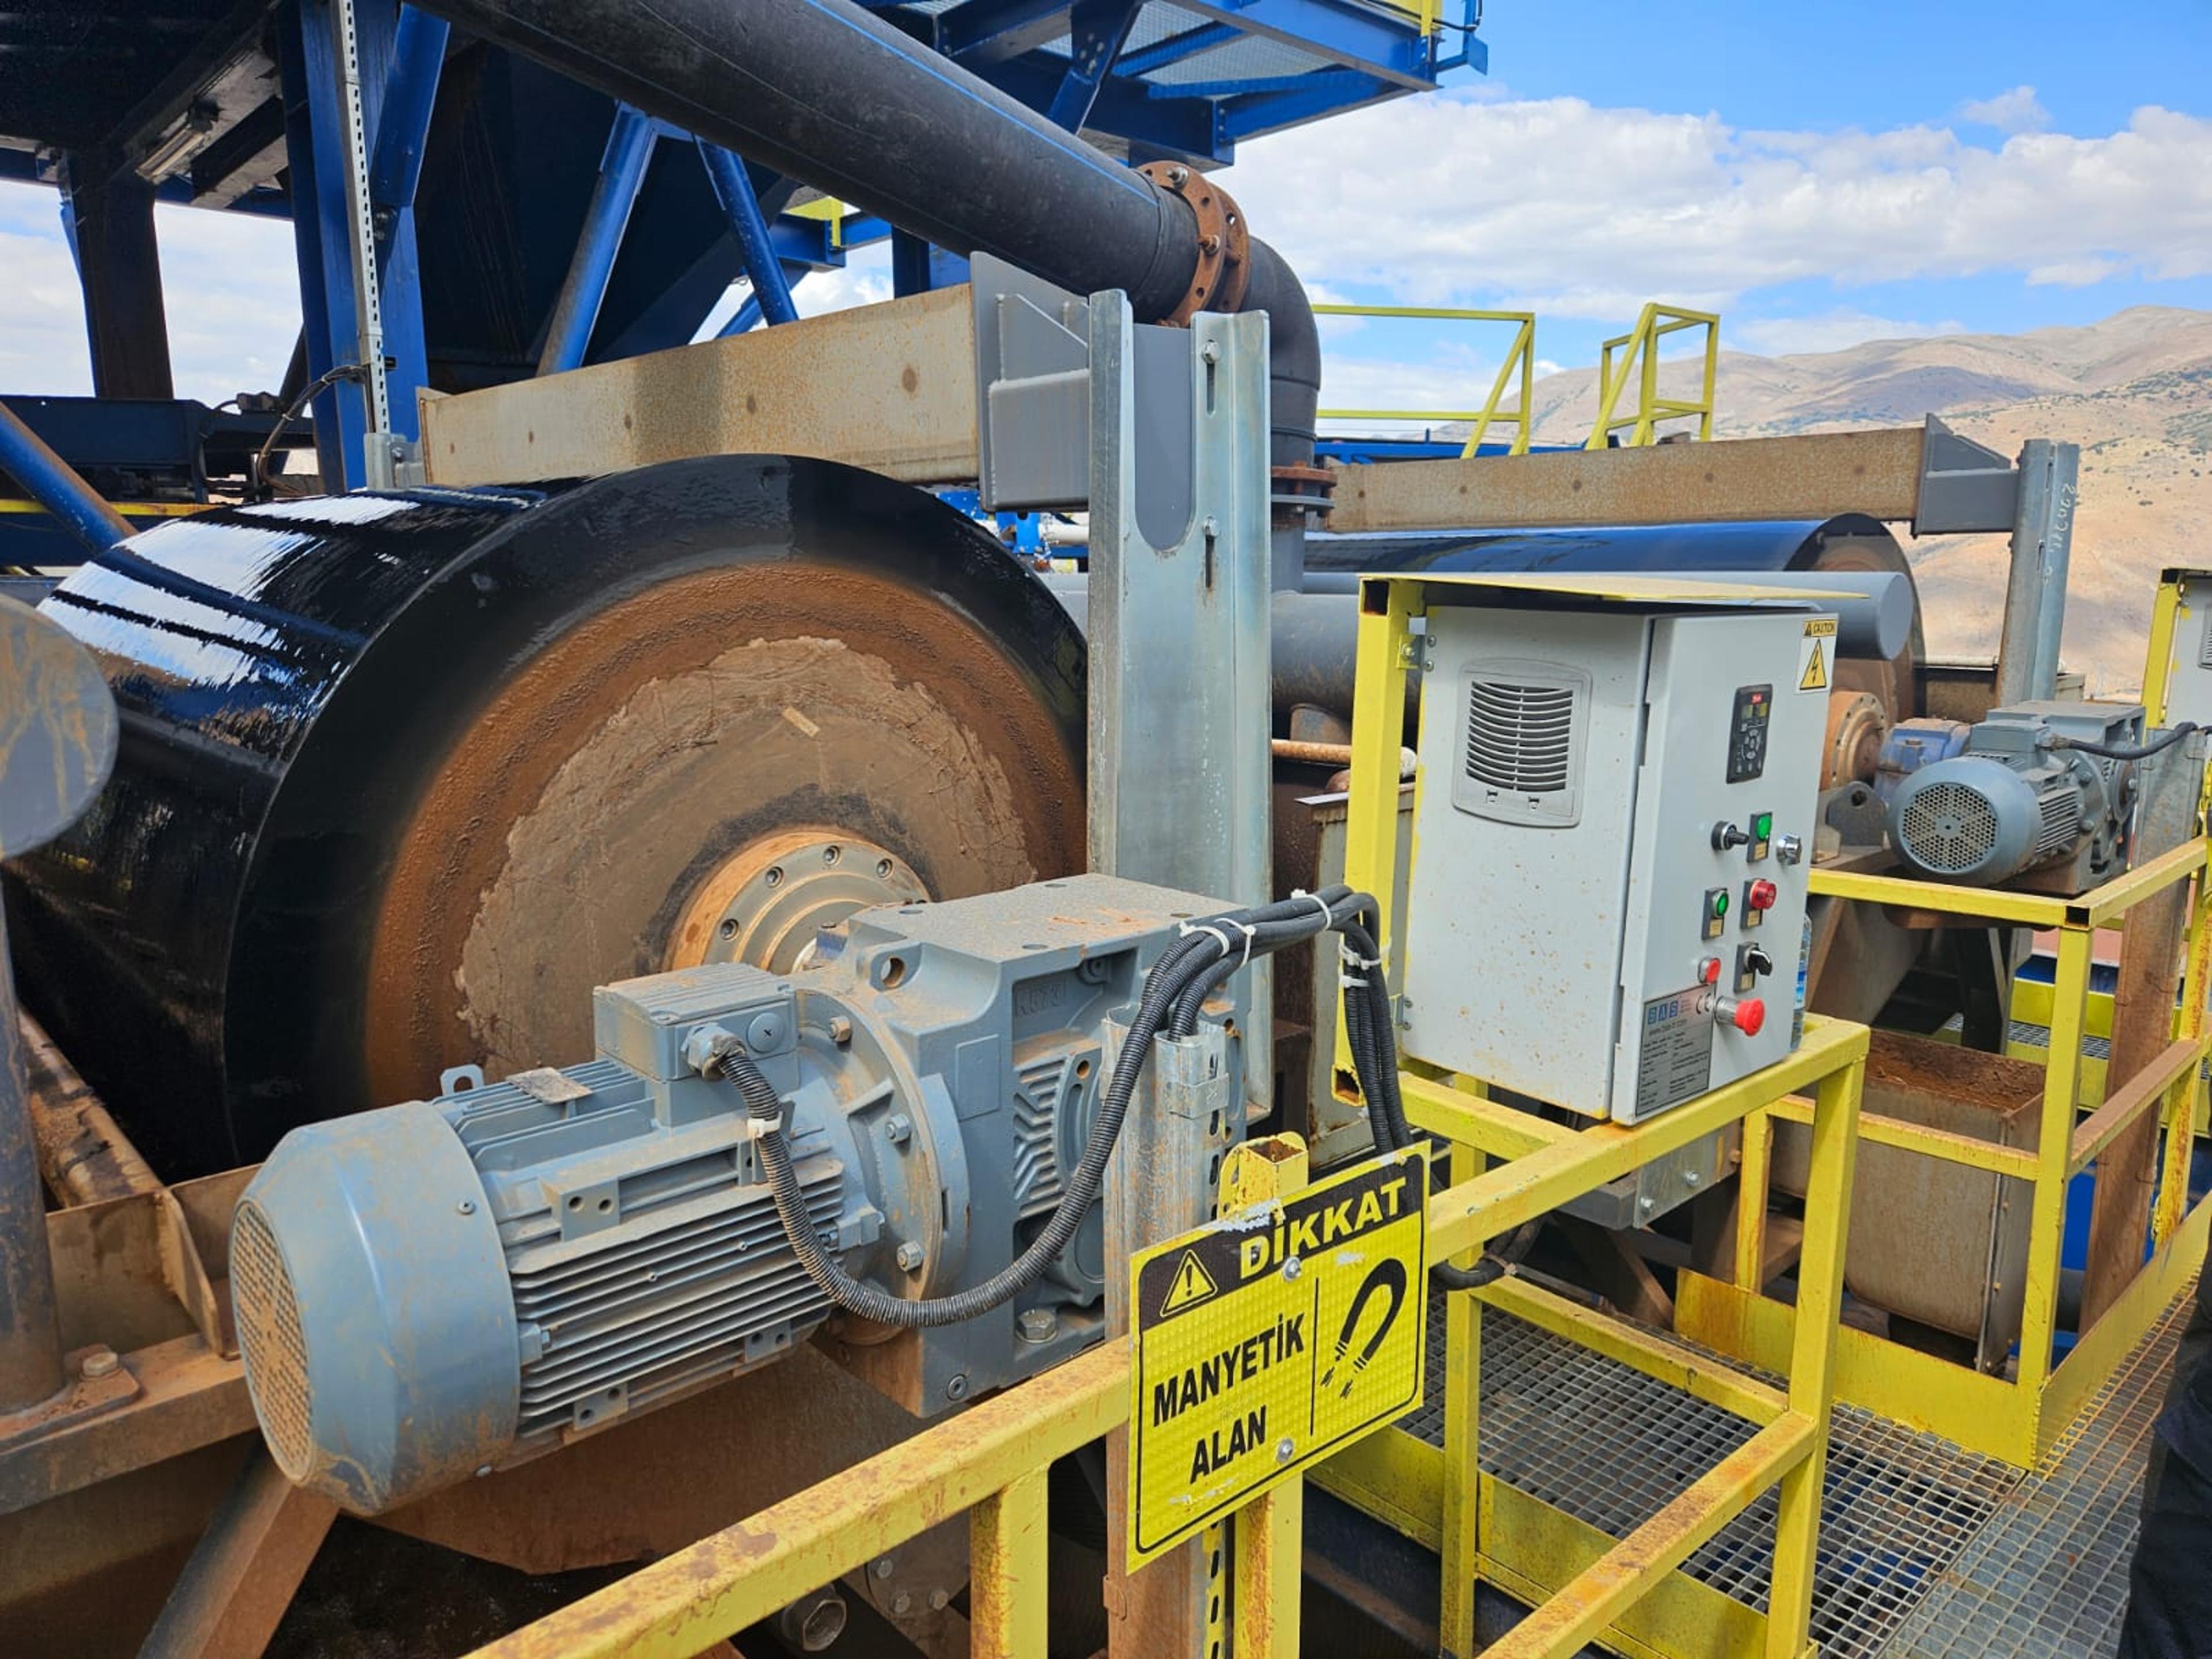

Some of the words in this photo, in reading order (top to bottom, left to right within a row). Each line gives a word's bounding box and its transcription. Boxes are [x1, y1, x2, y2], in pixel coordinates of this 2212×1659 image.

[1239, 1177, 1406, 1279] DİKKAT
[1154, 1313, 1304, 1427] MANYETİK
[1190, 1406, 1266, 1484] ALAN
